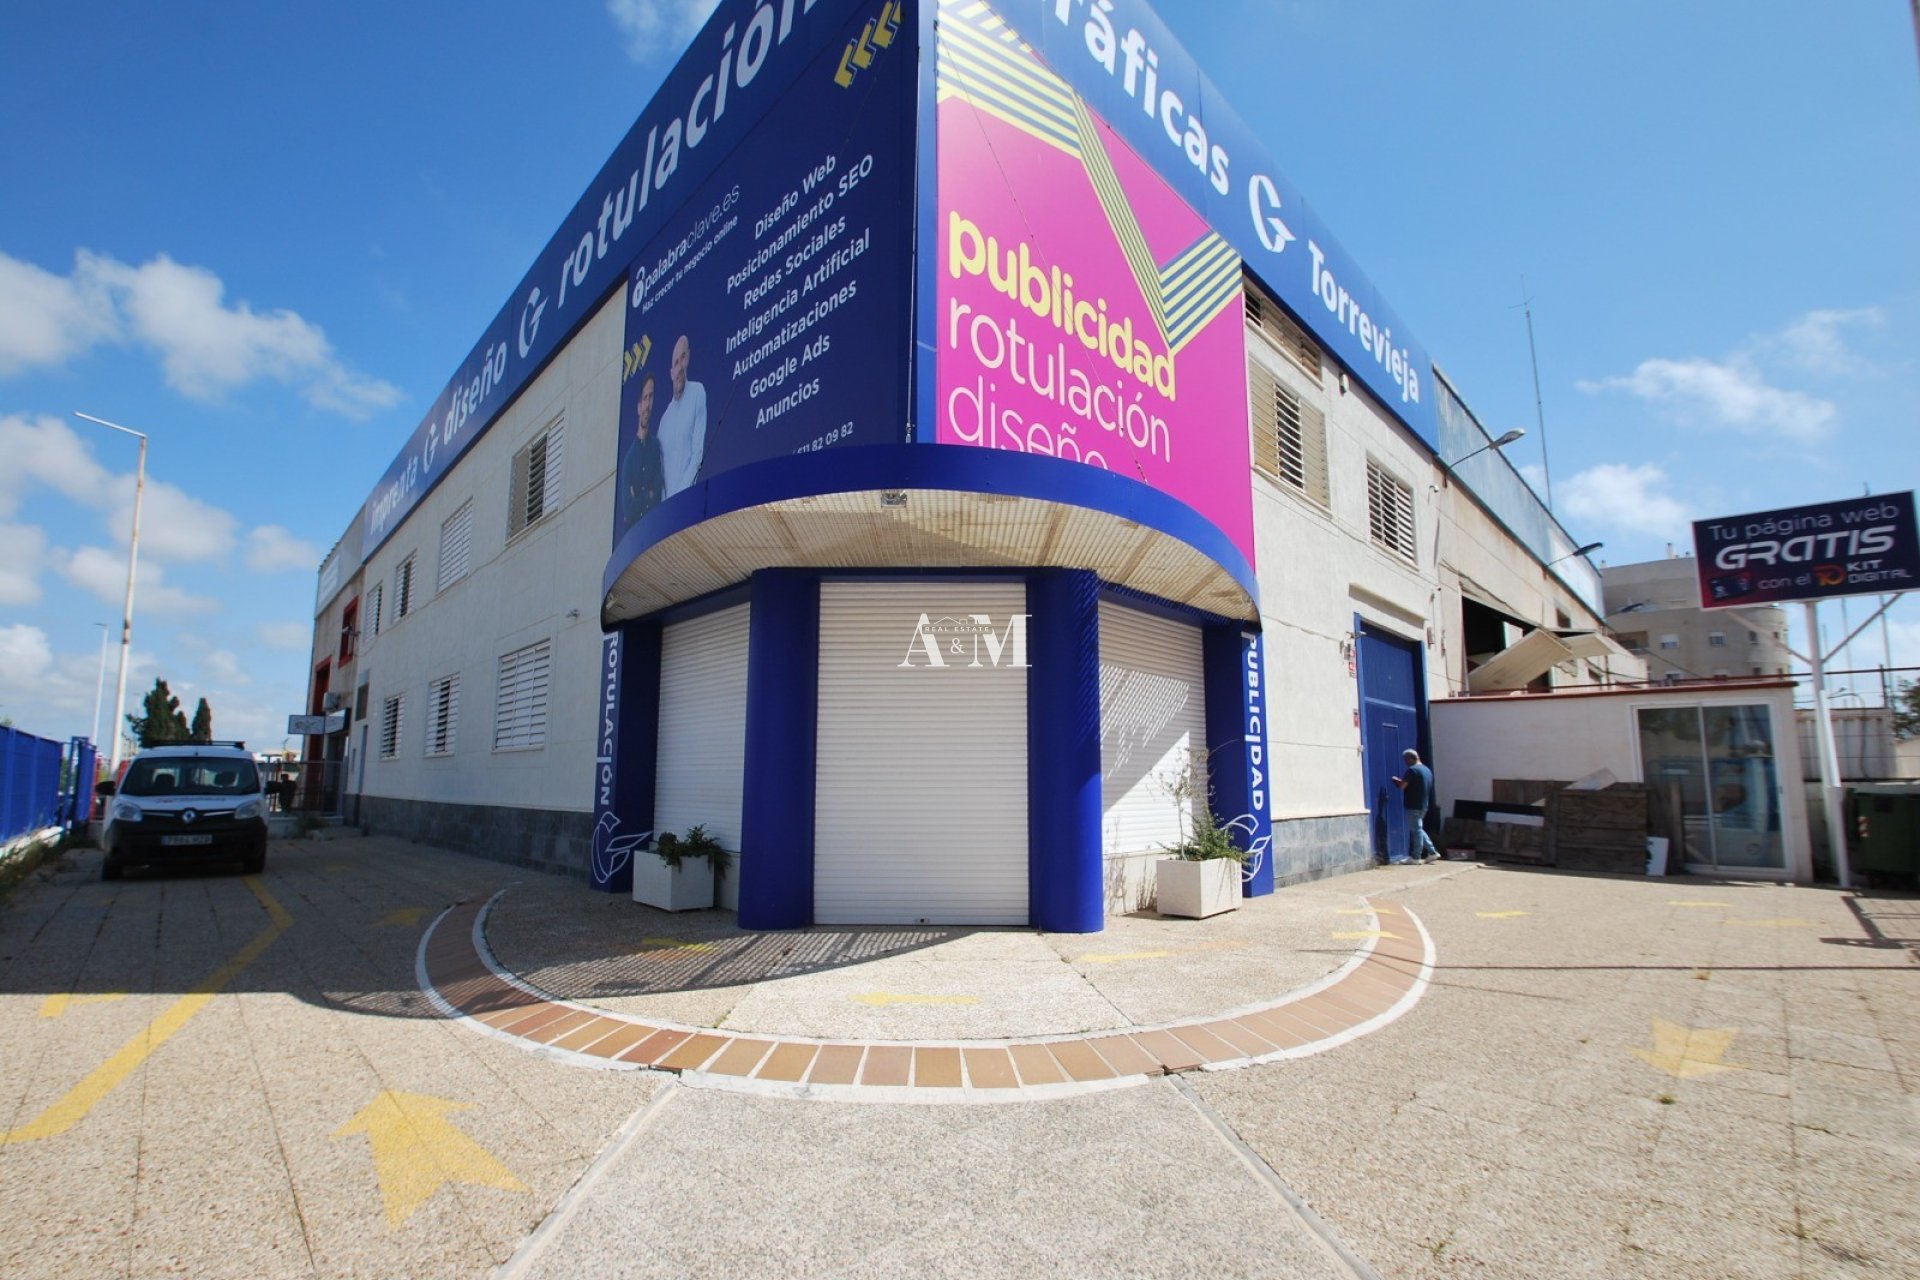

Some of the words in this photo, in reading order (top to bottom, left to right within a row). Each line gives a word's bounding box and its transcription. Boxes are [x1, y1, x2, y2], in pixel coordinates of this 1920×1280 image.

[644, 185, 739, 297] palabraclave.es
[727, 192, 834, 295] Posicionamiento
[839, 154, 873, 197] SEO
[755, 190, 799, 240] Diseño
[803, 154, 836, 194] Web
[655, 277, 674, 302] crecer
[676, 269, 684, 283] tu
[684, 240, 713, 274] negocio
[713, 215, 738, 244] online
[725, 288, 798, 354] Inteligencia
[802, 227, 870, 297] Artificial
[744, 268, 782, 310] Redes
[786, 216, 846, 275] Sociales
[732, 280, 857, 380] Automatizaciones
[949, 210, 1176, 402] publicidad
[1308, 239, 1420, 404] Torrevieja
[443, 341, 507, 446] diseño
[749, 357, 797, 398] Google
[801, 334, 830, 367] Ads
[756, 378, 820, 429] Anuncios
[950, 297, 1171, 463] rotulación
[811, 438, 824, 452] 82
[825, 429, 839, 445] 09
[841, 421, 854, 438] 82
[1708, 524, 1737, 542] Tu
[1745, 513, 1833, 540] página
[1840, 502, 1899, 525] web
[1715, 524, 1897, 570] GRATIS
[1846, 559, 1884, 572] KIT
[1757, 577, 1791, 590] con
[1794, 573, 1811, 586] el
[1847, 568, 1913, 584] DIGITAL
[597, 631, 619, 806] ROTULACIÓN
[1241, 631, 1264, 811] PUBLICIDAD
